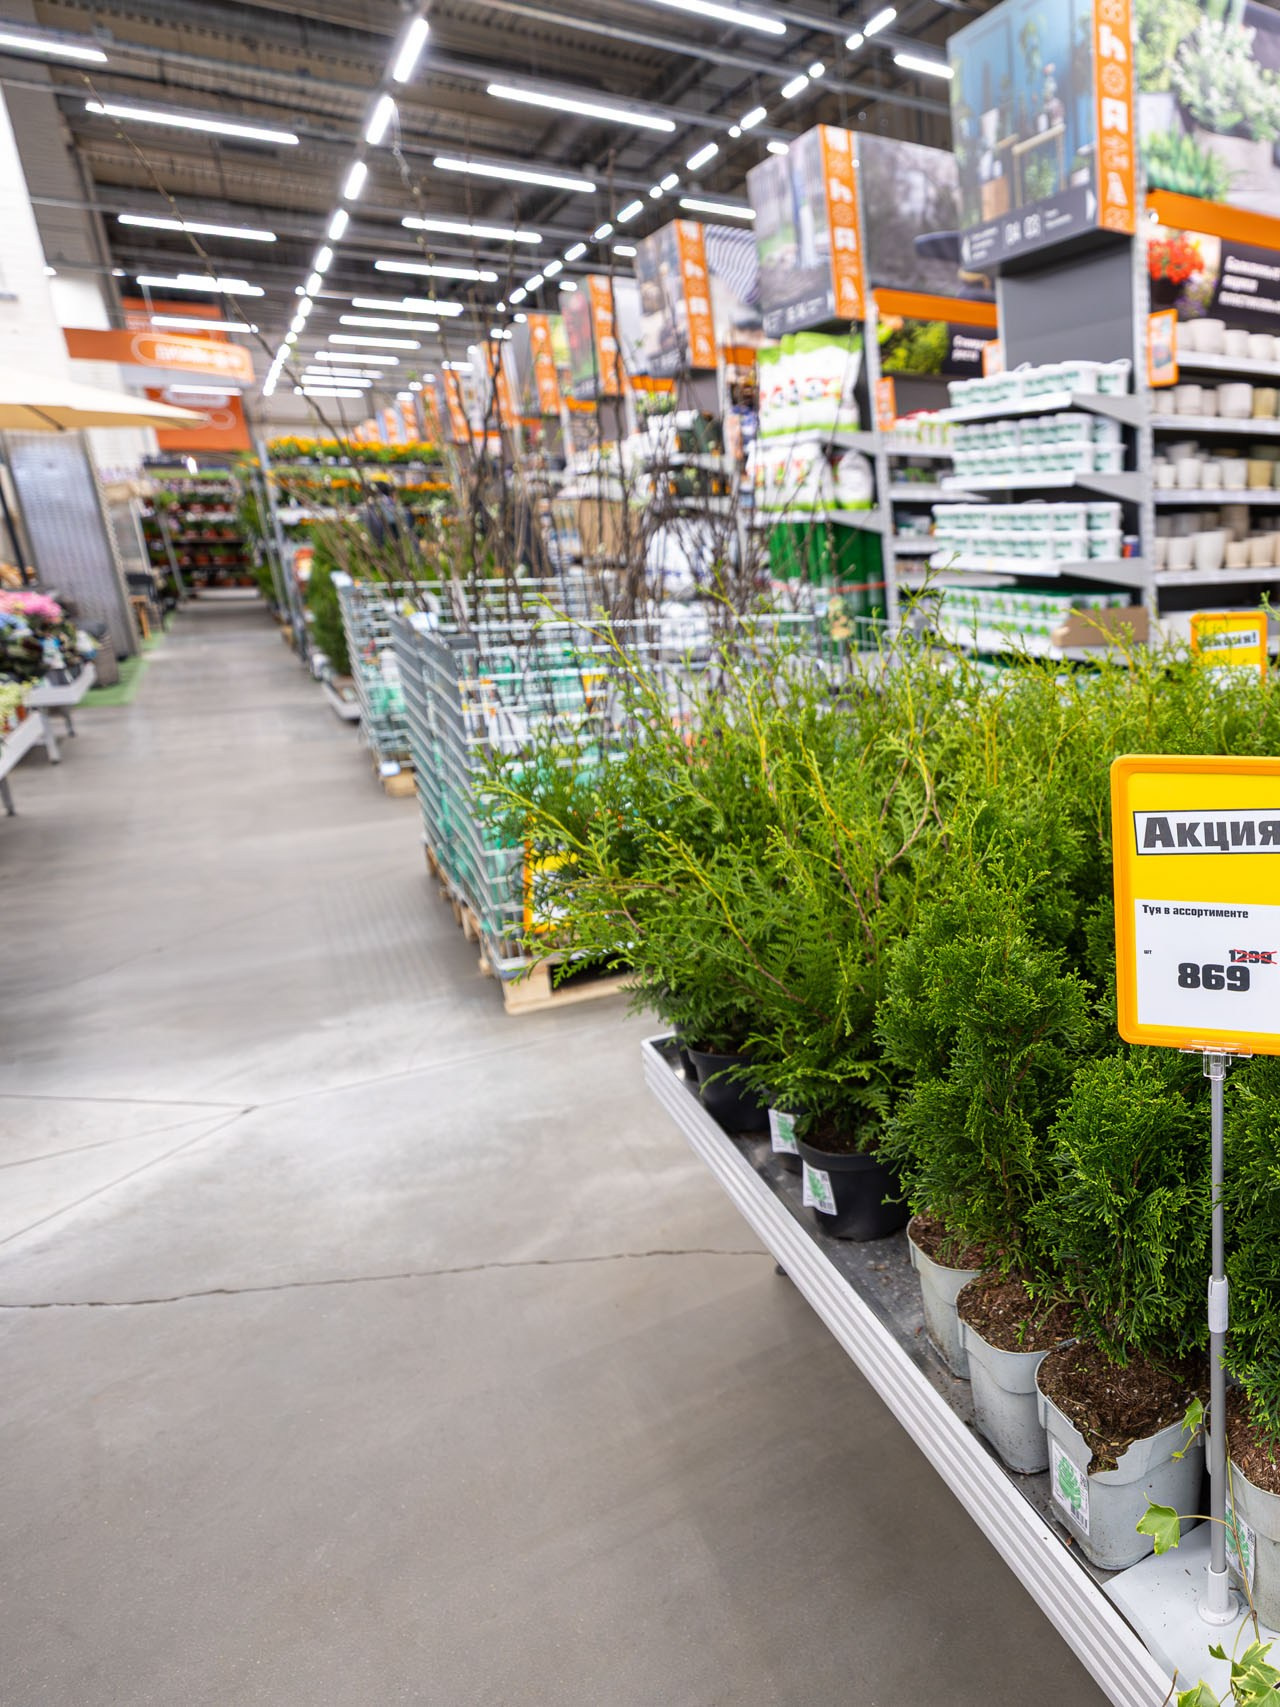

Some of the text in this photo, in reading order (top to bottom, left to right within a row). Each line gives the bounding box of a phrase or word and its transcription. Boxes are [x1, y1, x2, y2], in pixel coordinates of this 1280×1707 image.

[1142, 904, 1249, 918] Туя в ассортименте
[1178, 962, 1250, 992] 869
